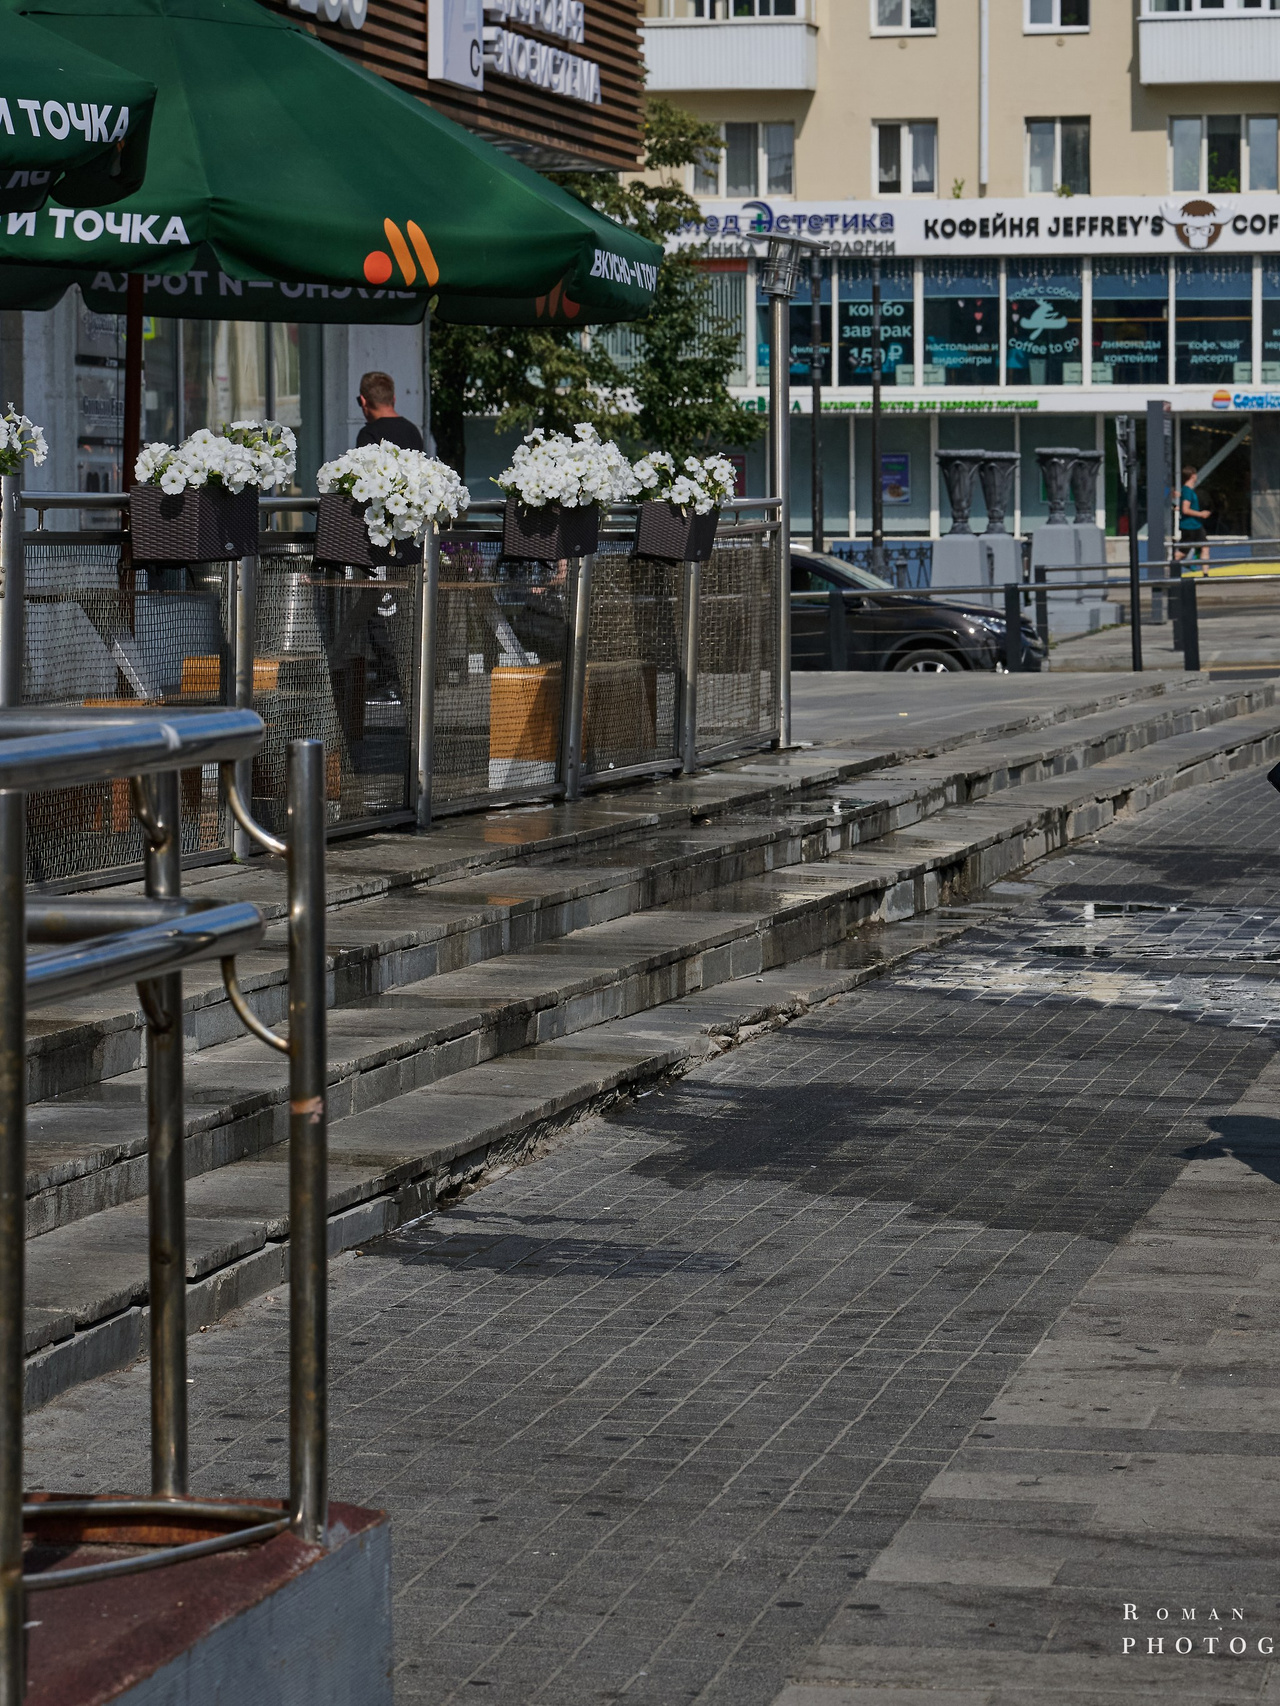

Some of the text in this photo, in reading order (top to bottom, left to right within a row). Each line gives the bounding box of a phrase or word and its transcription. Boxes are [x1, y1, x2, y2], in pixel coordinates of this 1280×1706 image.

[17, 98, 129, 143] ТОЧКА
[49, 207, 191, 245] ТОЧКА
[924, 212, 1040, 240] КОФЕЙНЯ
[1048, 214, 1165, 238] JEFFREY'S
[590, 248, 632, 286] ВКУСНО
[842, 325, 912, 342] заврак
[1048, 343, 1063, 355] to
[1063, 337, 1080, 353] go
[1100, 340, 1162, 351] лимонады
[1221, 339, 1241, 350] чай
[932, 356, 993, 367] видеоигры
[1103, 352, 1158, 364] коктейли
[1190, 354, 1239, 365] десерты
